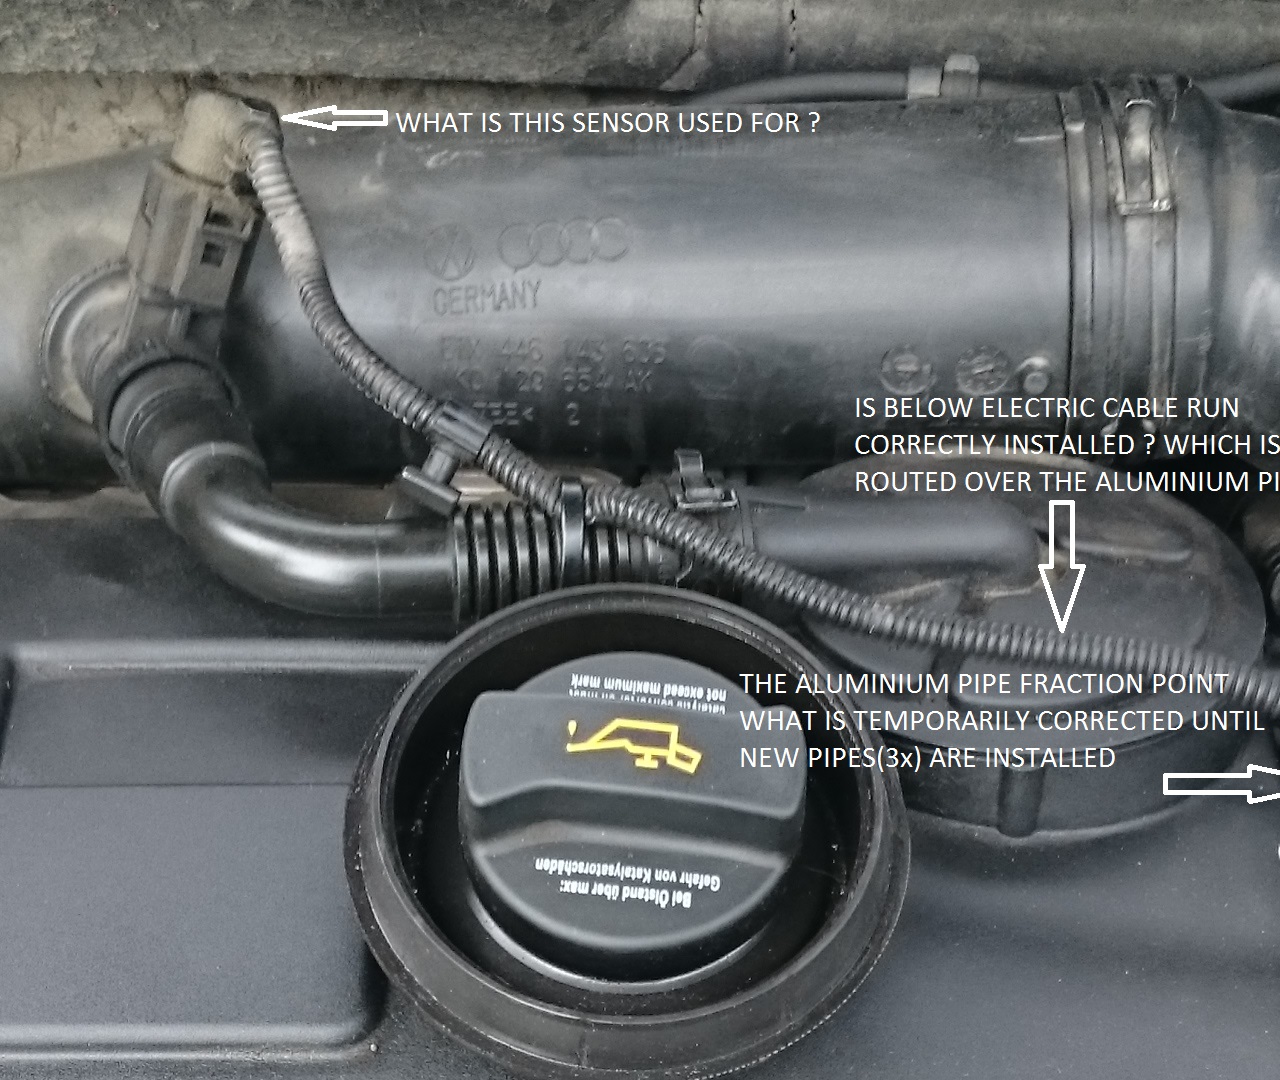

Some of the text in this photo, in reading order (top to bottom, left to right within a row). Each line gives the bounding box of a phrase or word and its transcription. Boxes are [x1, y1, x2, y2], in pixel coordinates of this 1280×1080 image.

[433, 279, 542, 316] GERMANY
[571, 673, 601, 689] mark
[603, 677, 661, 695] maximum
[654, 869, 677, 883] von
[679, 871, 721, 892] Gefahr
